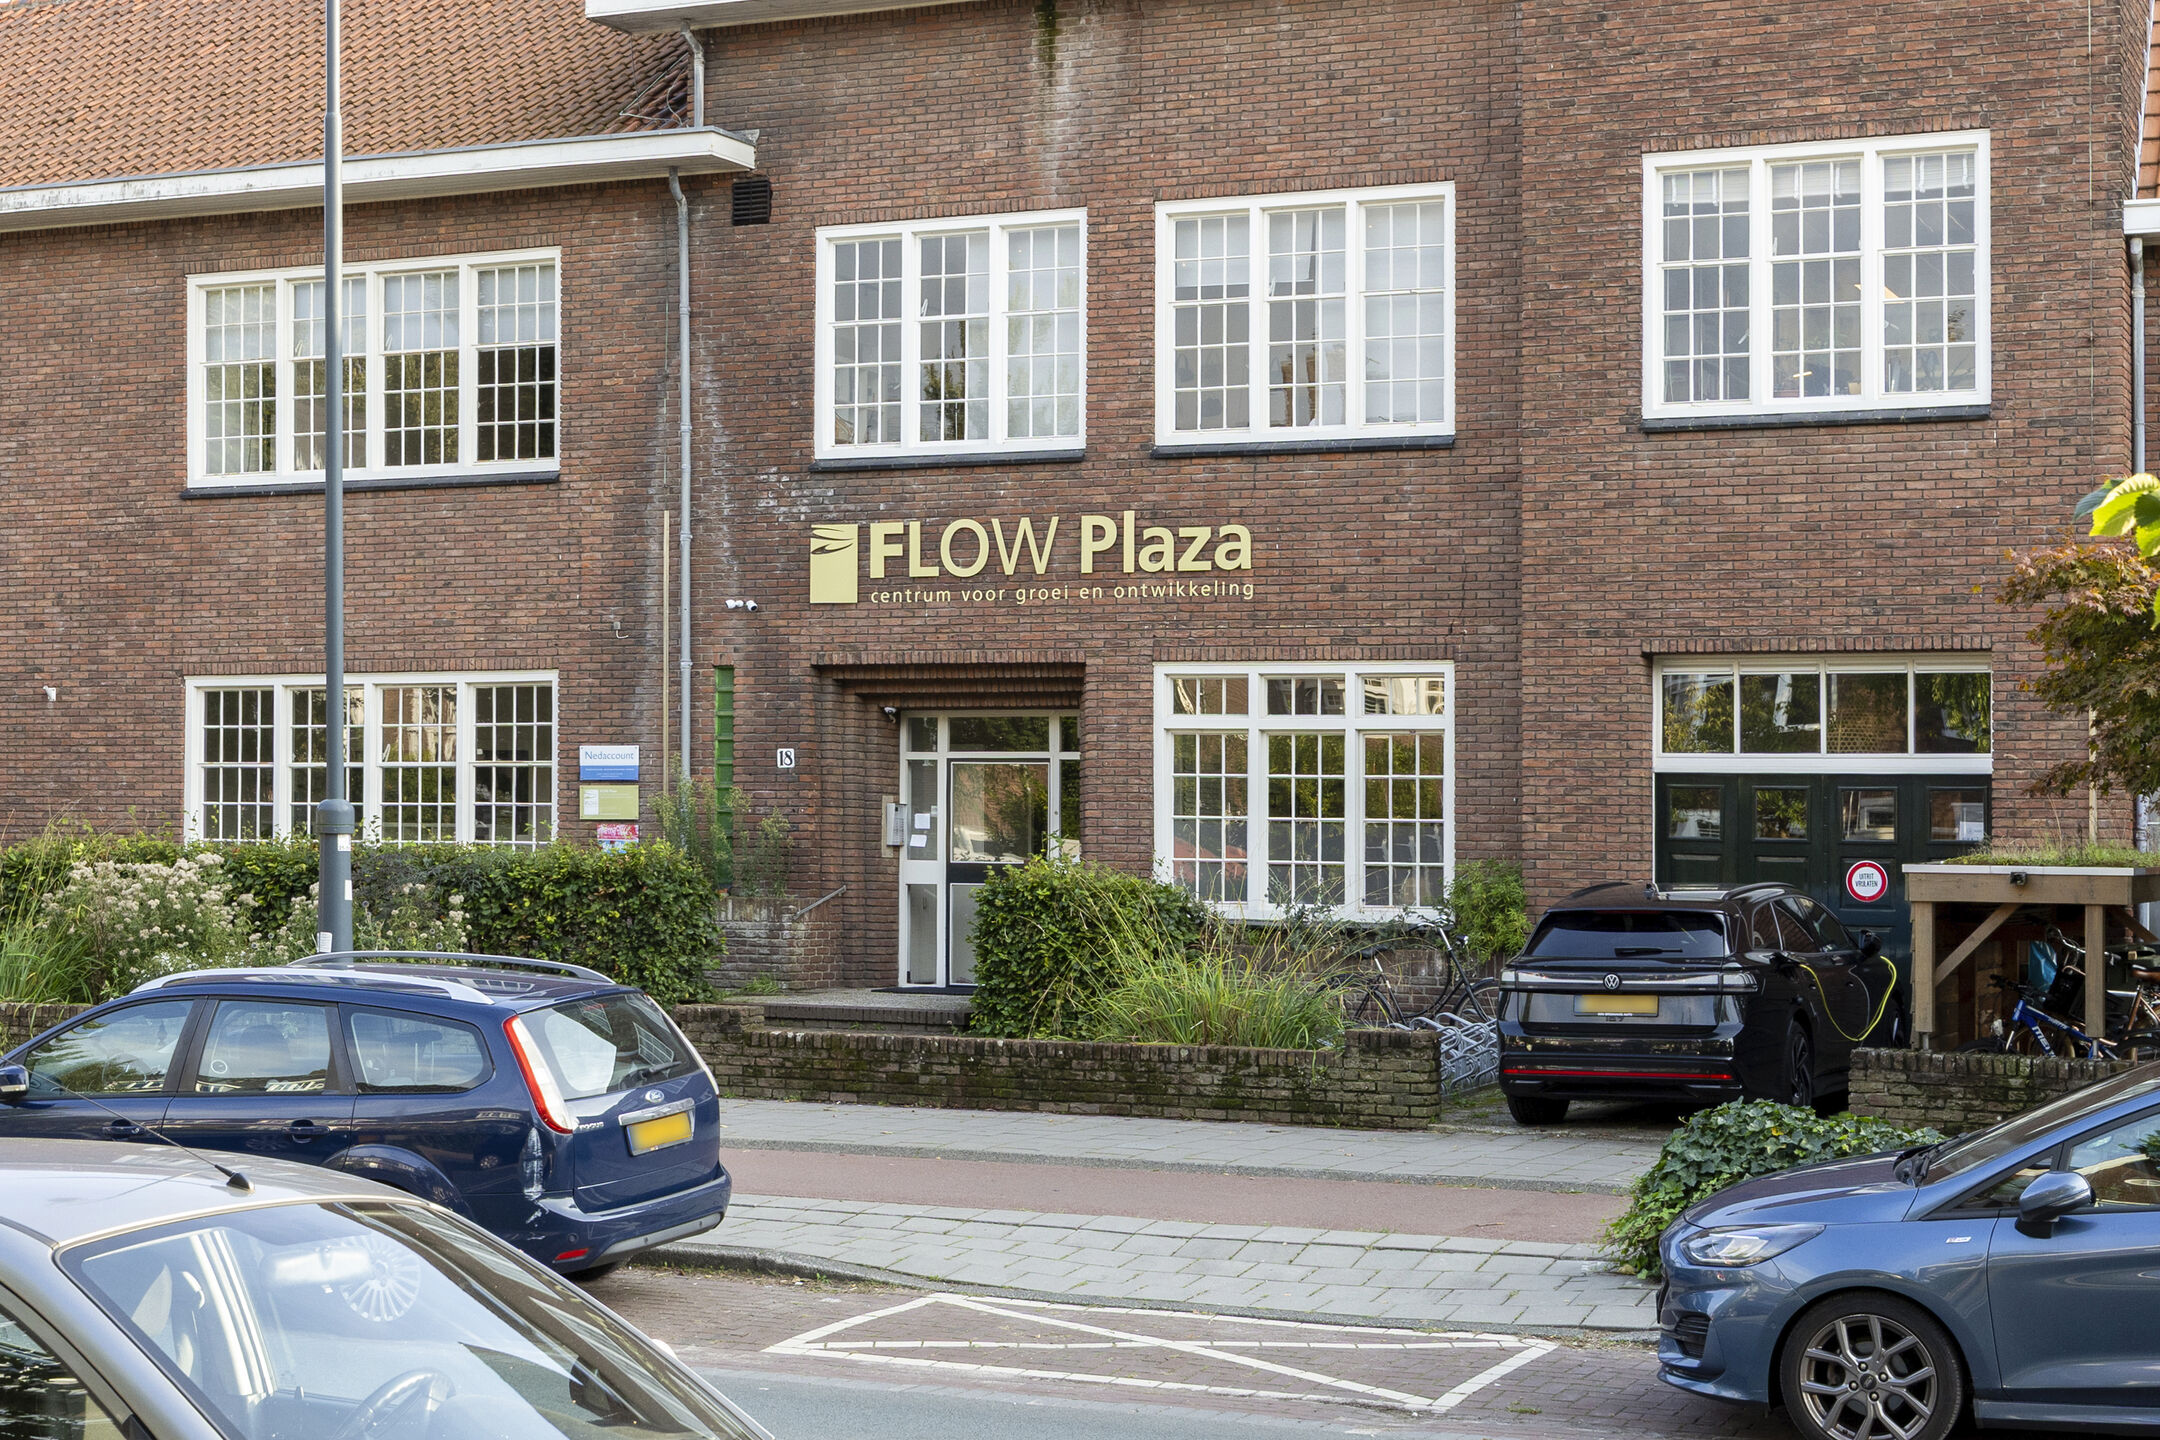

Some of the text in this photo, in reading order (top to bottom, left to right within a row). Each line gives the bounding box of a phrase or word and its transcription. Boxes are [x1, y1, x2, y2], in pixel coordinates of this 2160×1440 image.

[869, 510, 1253, 579] FLOW Plaza
[870, 579, 1255, 605] centrum voor groei en ontwikkeling
[585, 751, 634, 760] Nedaccount
[779, 750, 793, 766] 18
